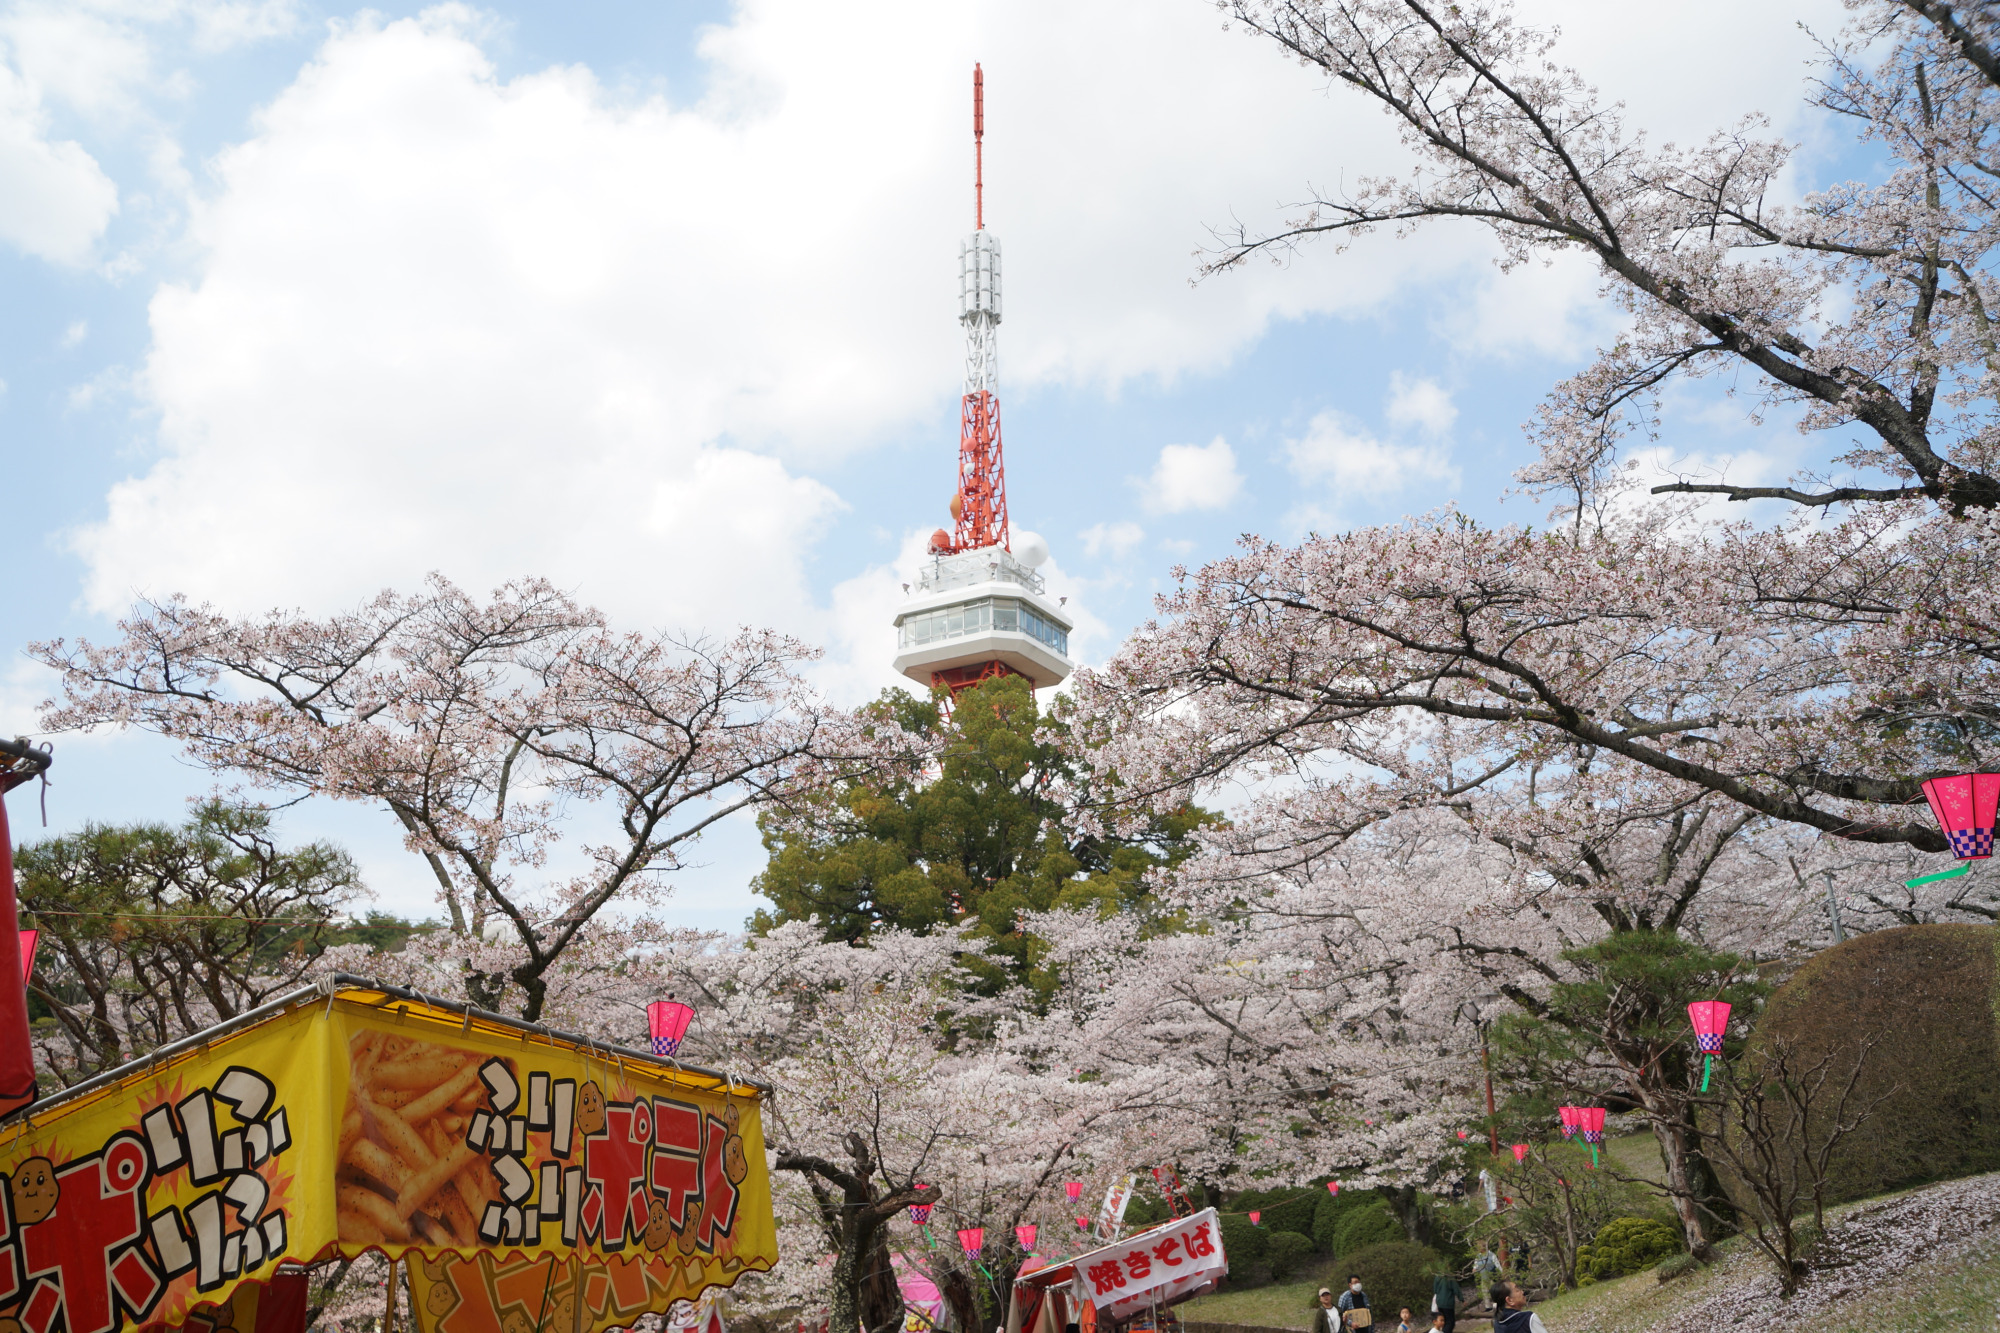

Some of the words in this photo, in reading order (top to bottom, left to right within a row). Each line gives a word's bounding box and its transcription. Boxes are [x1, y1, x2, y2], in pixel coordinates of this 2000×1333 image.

[580, 1095, 738, 1254] ポテト
[1087, 1220, 1216, 1297] 焼きそば
